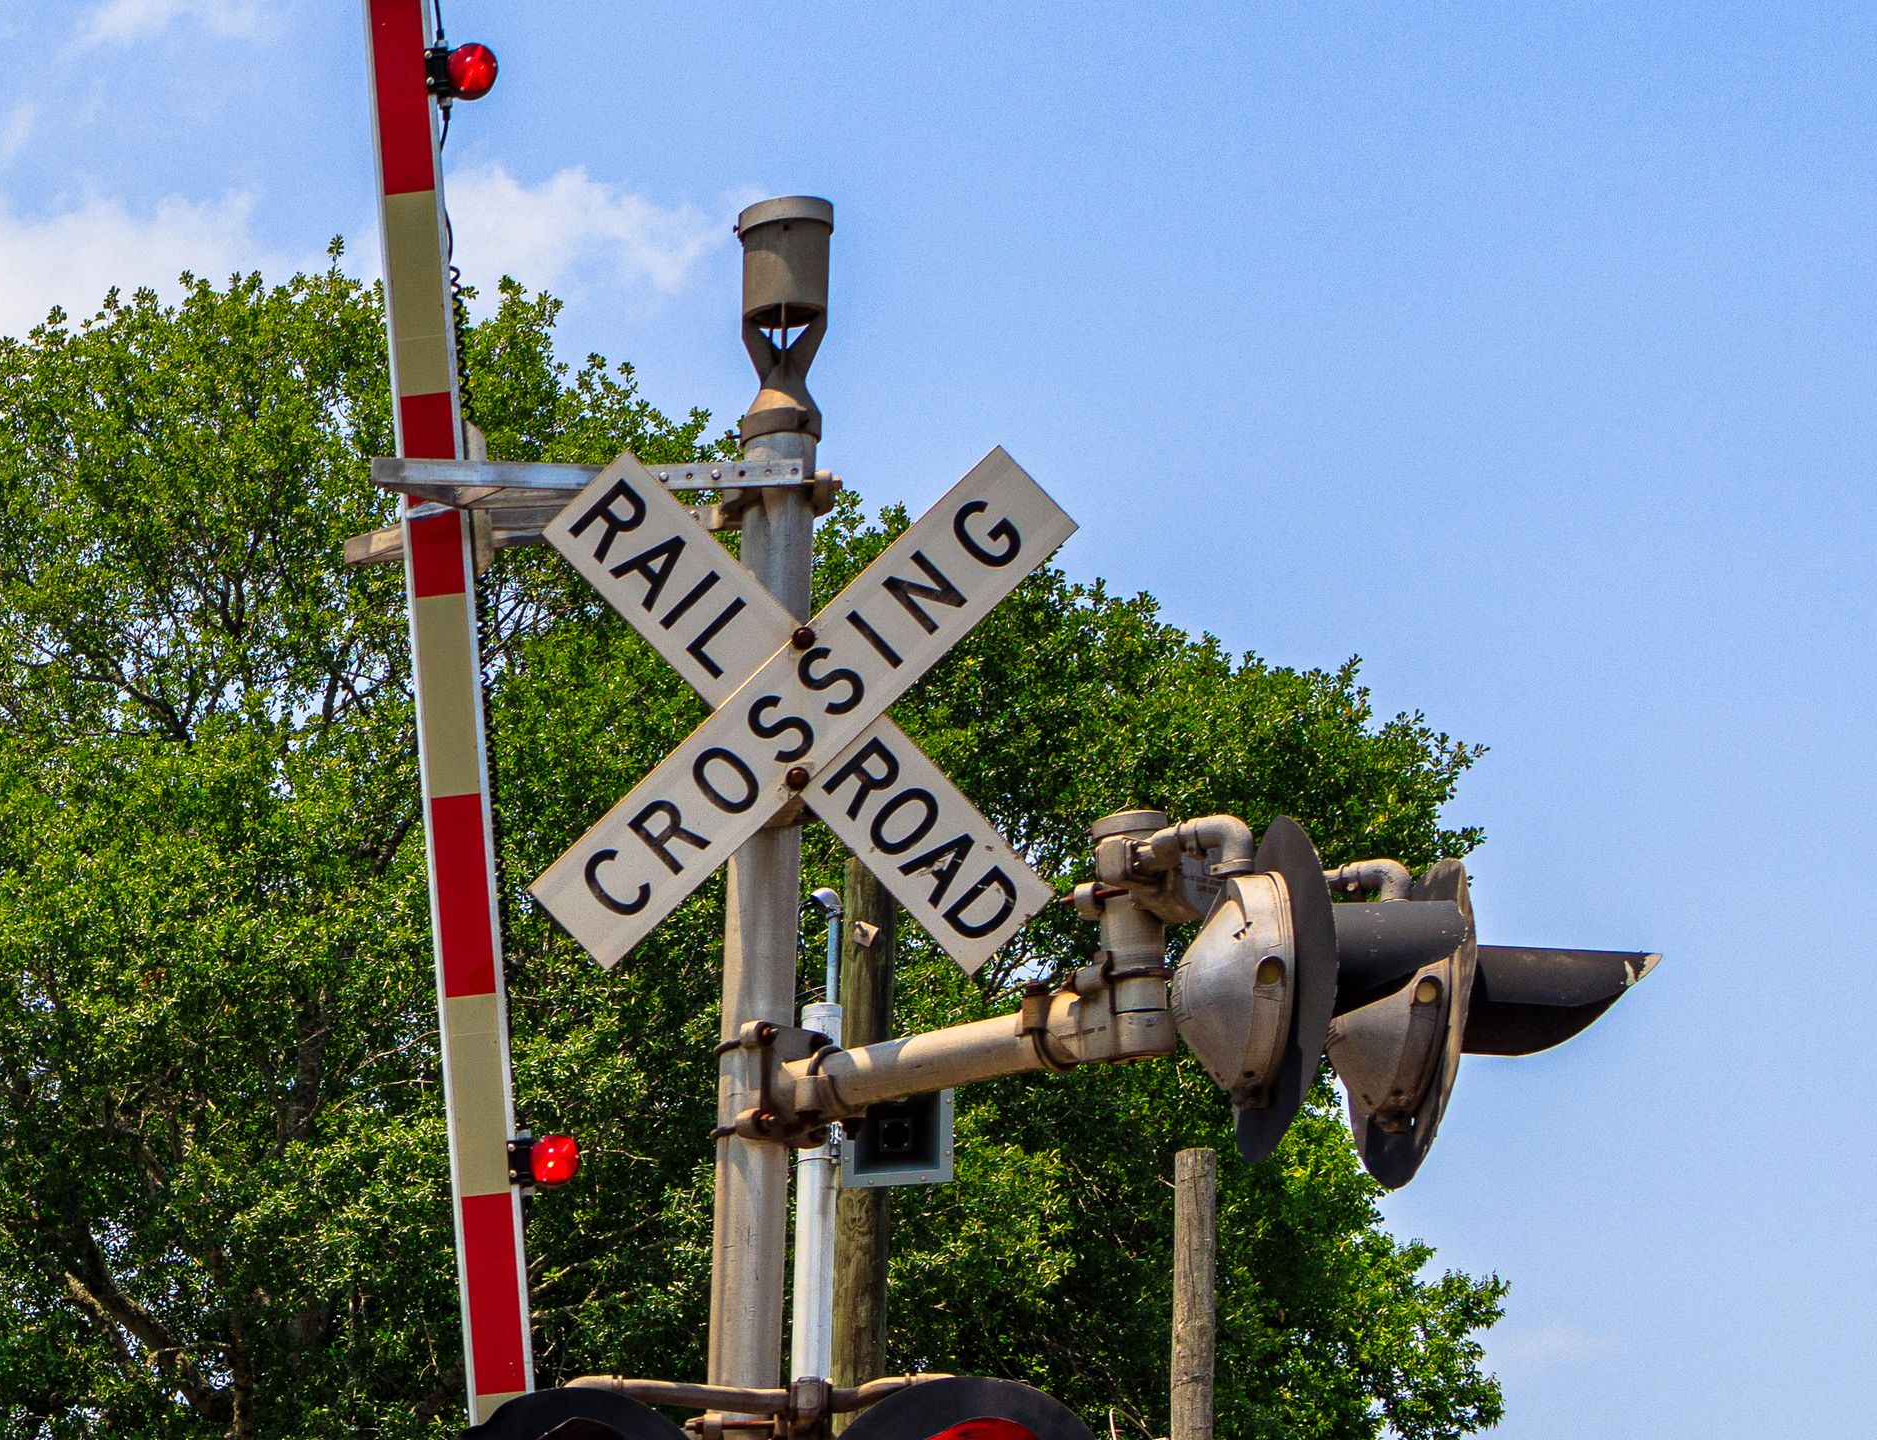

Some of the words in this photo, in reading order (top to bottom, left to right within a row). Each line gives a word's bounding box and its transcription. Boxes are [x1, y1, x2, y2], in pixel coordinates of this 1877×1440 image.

[568, 478, 747, 679] RAIL
[584, 500, 1022, 917] CROSSING
[821, 736, 1018, 939] ROAD
